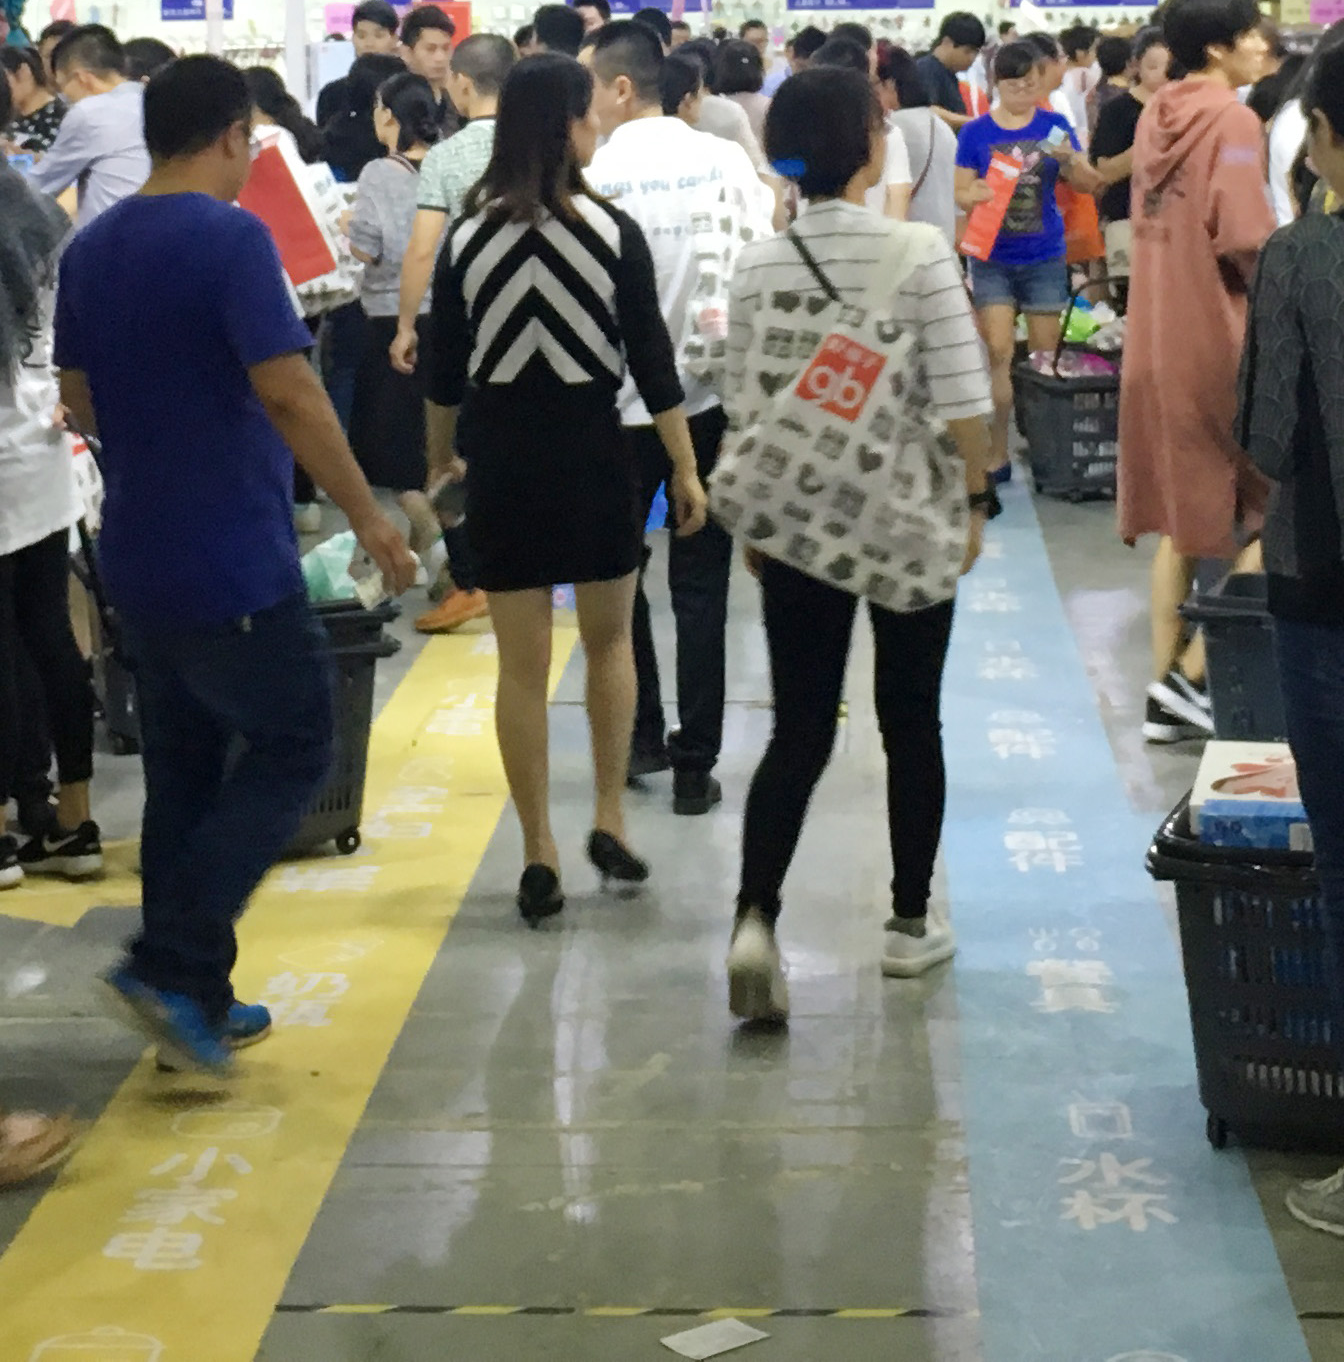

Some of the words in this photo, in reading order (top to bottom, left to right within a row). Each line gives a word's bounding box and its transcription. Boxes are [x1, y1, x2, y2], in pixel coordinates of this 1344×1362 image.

[807, 364, 866, 409] gb
[102, 1145, 254, 1272] 小家电
[1057, 1150, 1180, 1233] 水杯
